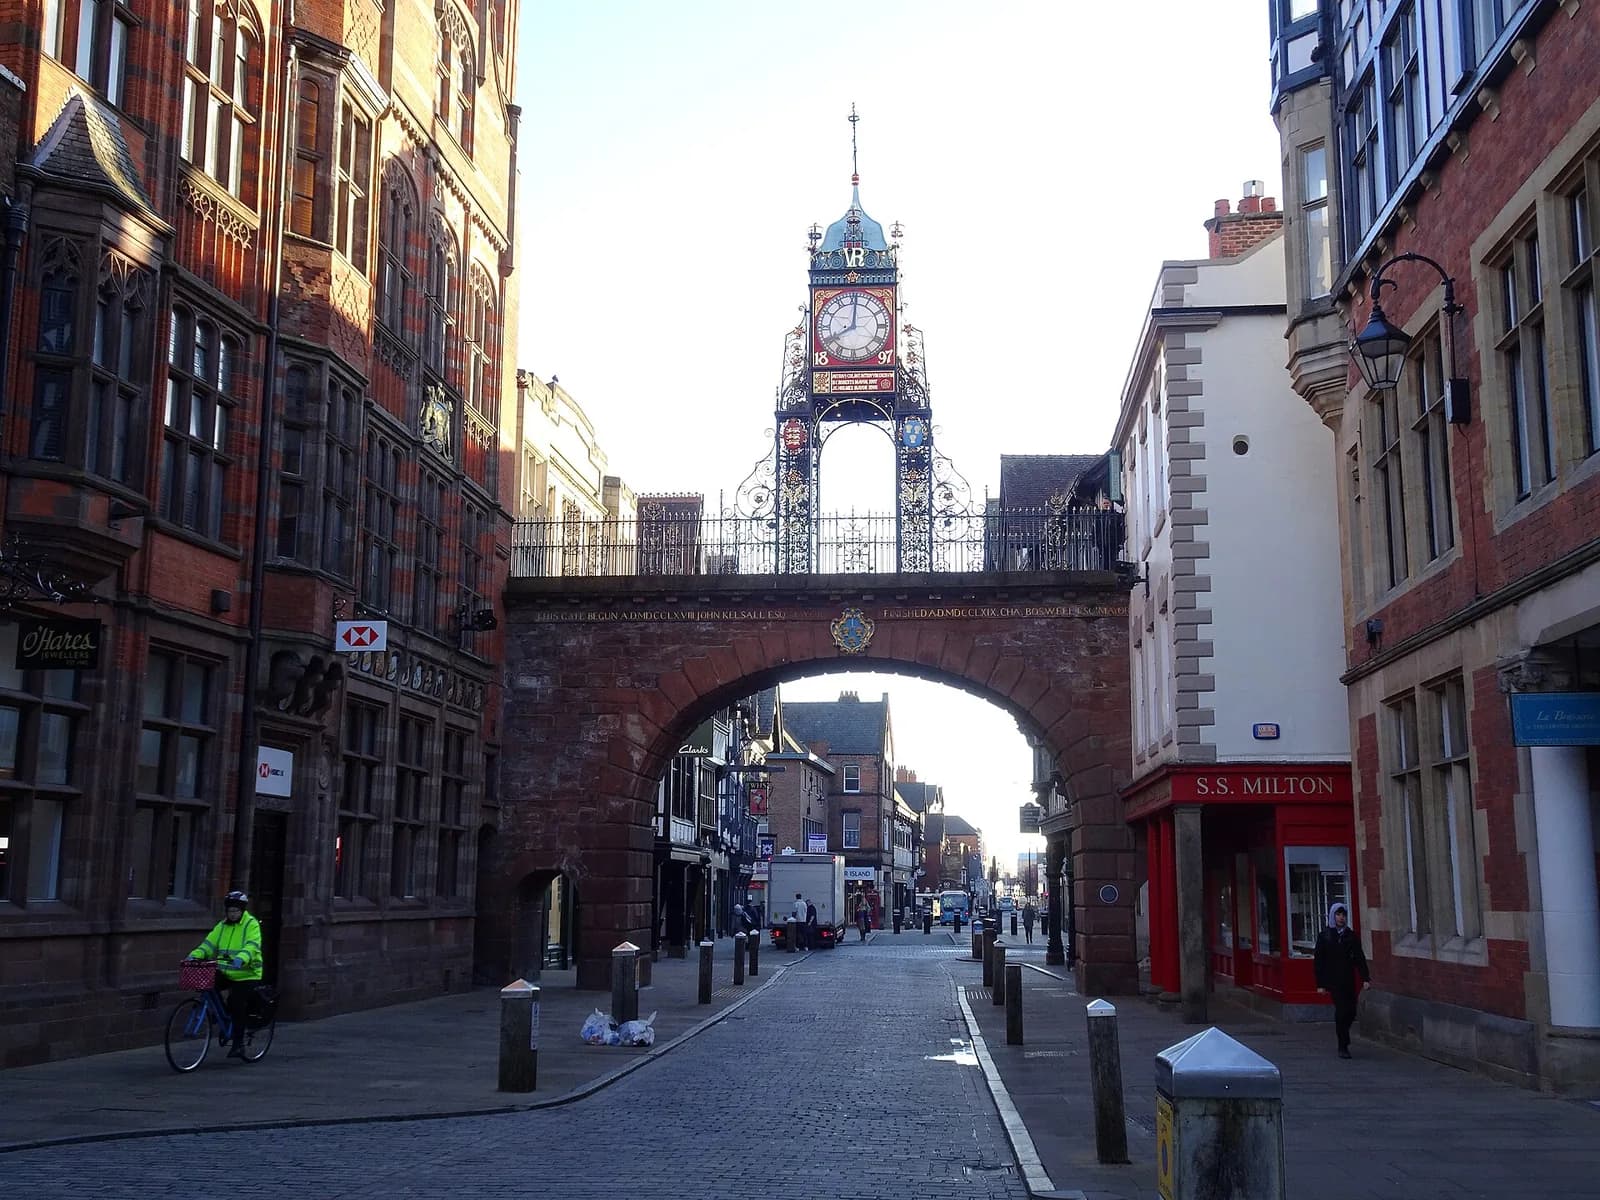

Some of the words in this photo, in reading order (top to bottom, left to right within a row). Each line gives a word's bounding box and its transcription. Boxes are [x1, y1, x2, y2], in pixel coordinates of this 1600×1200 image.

[815, 351, 829, 365] 18
[878, 350, 893, 364] 97
[23, 624, 97, 658] O'Hares
[678, 744, 709, 754] Clarks
[1196, 777, 1234, 795] S.S.
[1242, 777, 1333, 794] MILTON
